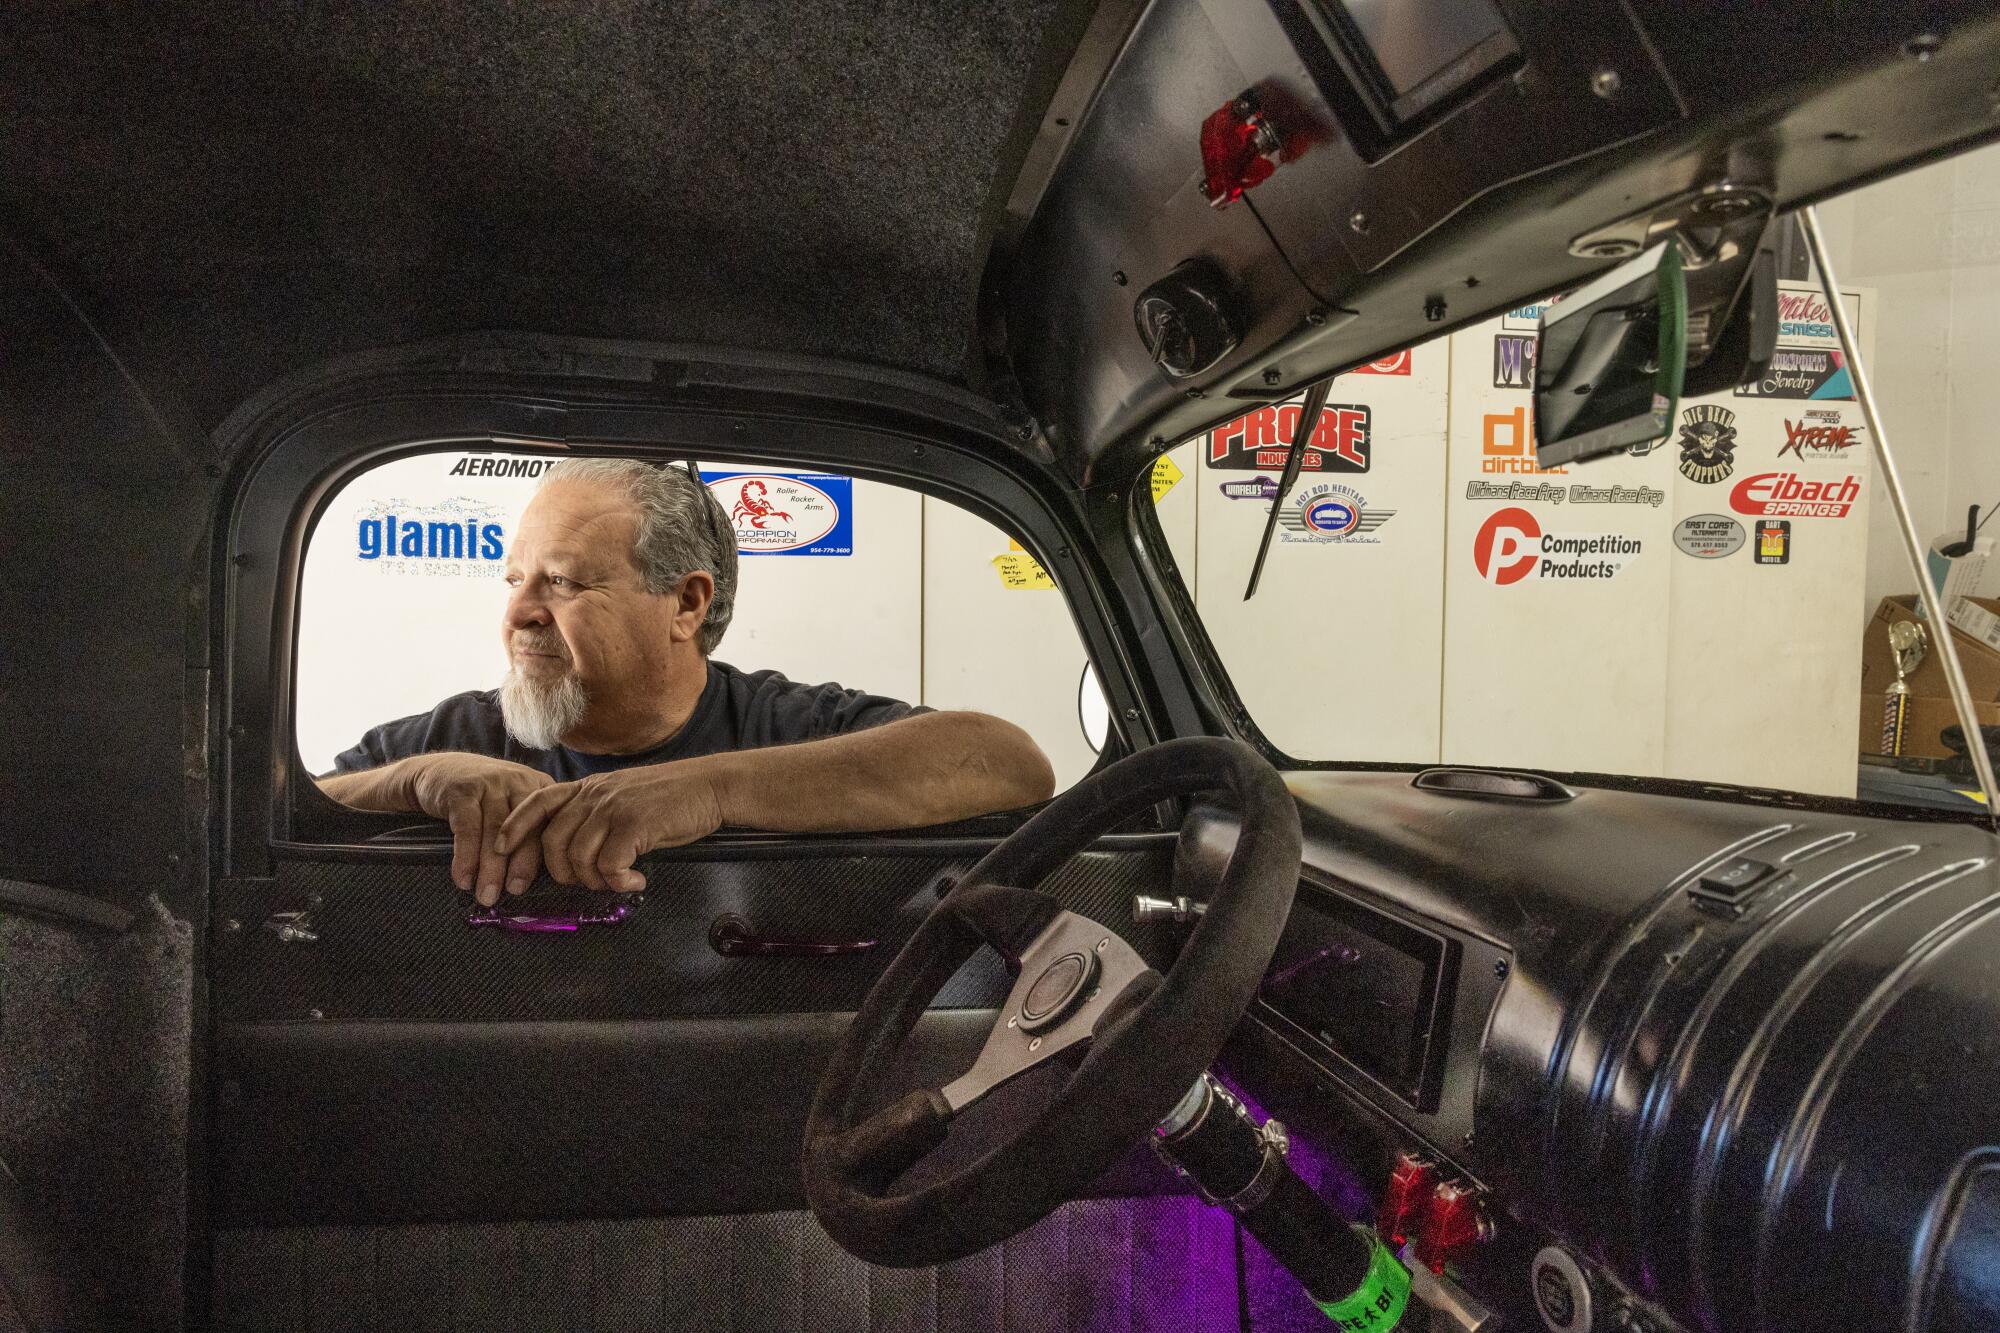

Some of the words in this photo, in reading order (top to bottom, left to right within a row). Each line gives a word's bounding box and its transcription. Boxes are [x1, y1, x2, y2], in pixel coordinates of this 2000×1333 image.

[1763, 370, 1815, 394] Jewelry
[449, 458, 562, 478] AEROMOT
[790, 495, 816, 503] Rocker
[1295, 491, 1310, 507] HOT
[1312, 484, 1329, 495] ROD
[1332, 484, 1368, 508] HERITAGE
[1510, 482, 1538, 500] Race
[1610, 486, 1639, 504] Race
[1730, 473, 1861, 506] Eibach
[1763, 503, 1843, 517] SPRINGS
[736, 530, 797, 538] CORPION
[1685, 521, 1707, 529] EAST
[1708, 521, 1735, 529] COAST
[358, 515, 504, 560] glamis
[1541, 534, 1642, 557] Competition
[1540, 560, 1614, 579] Products
